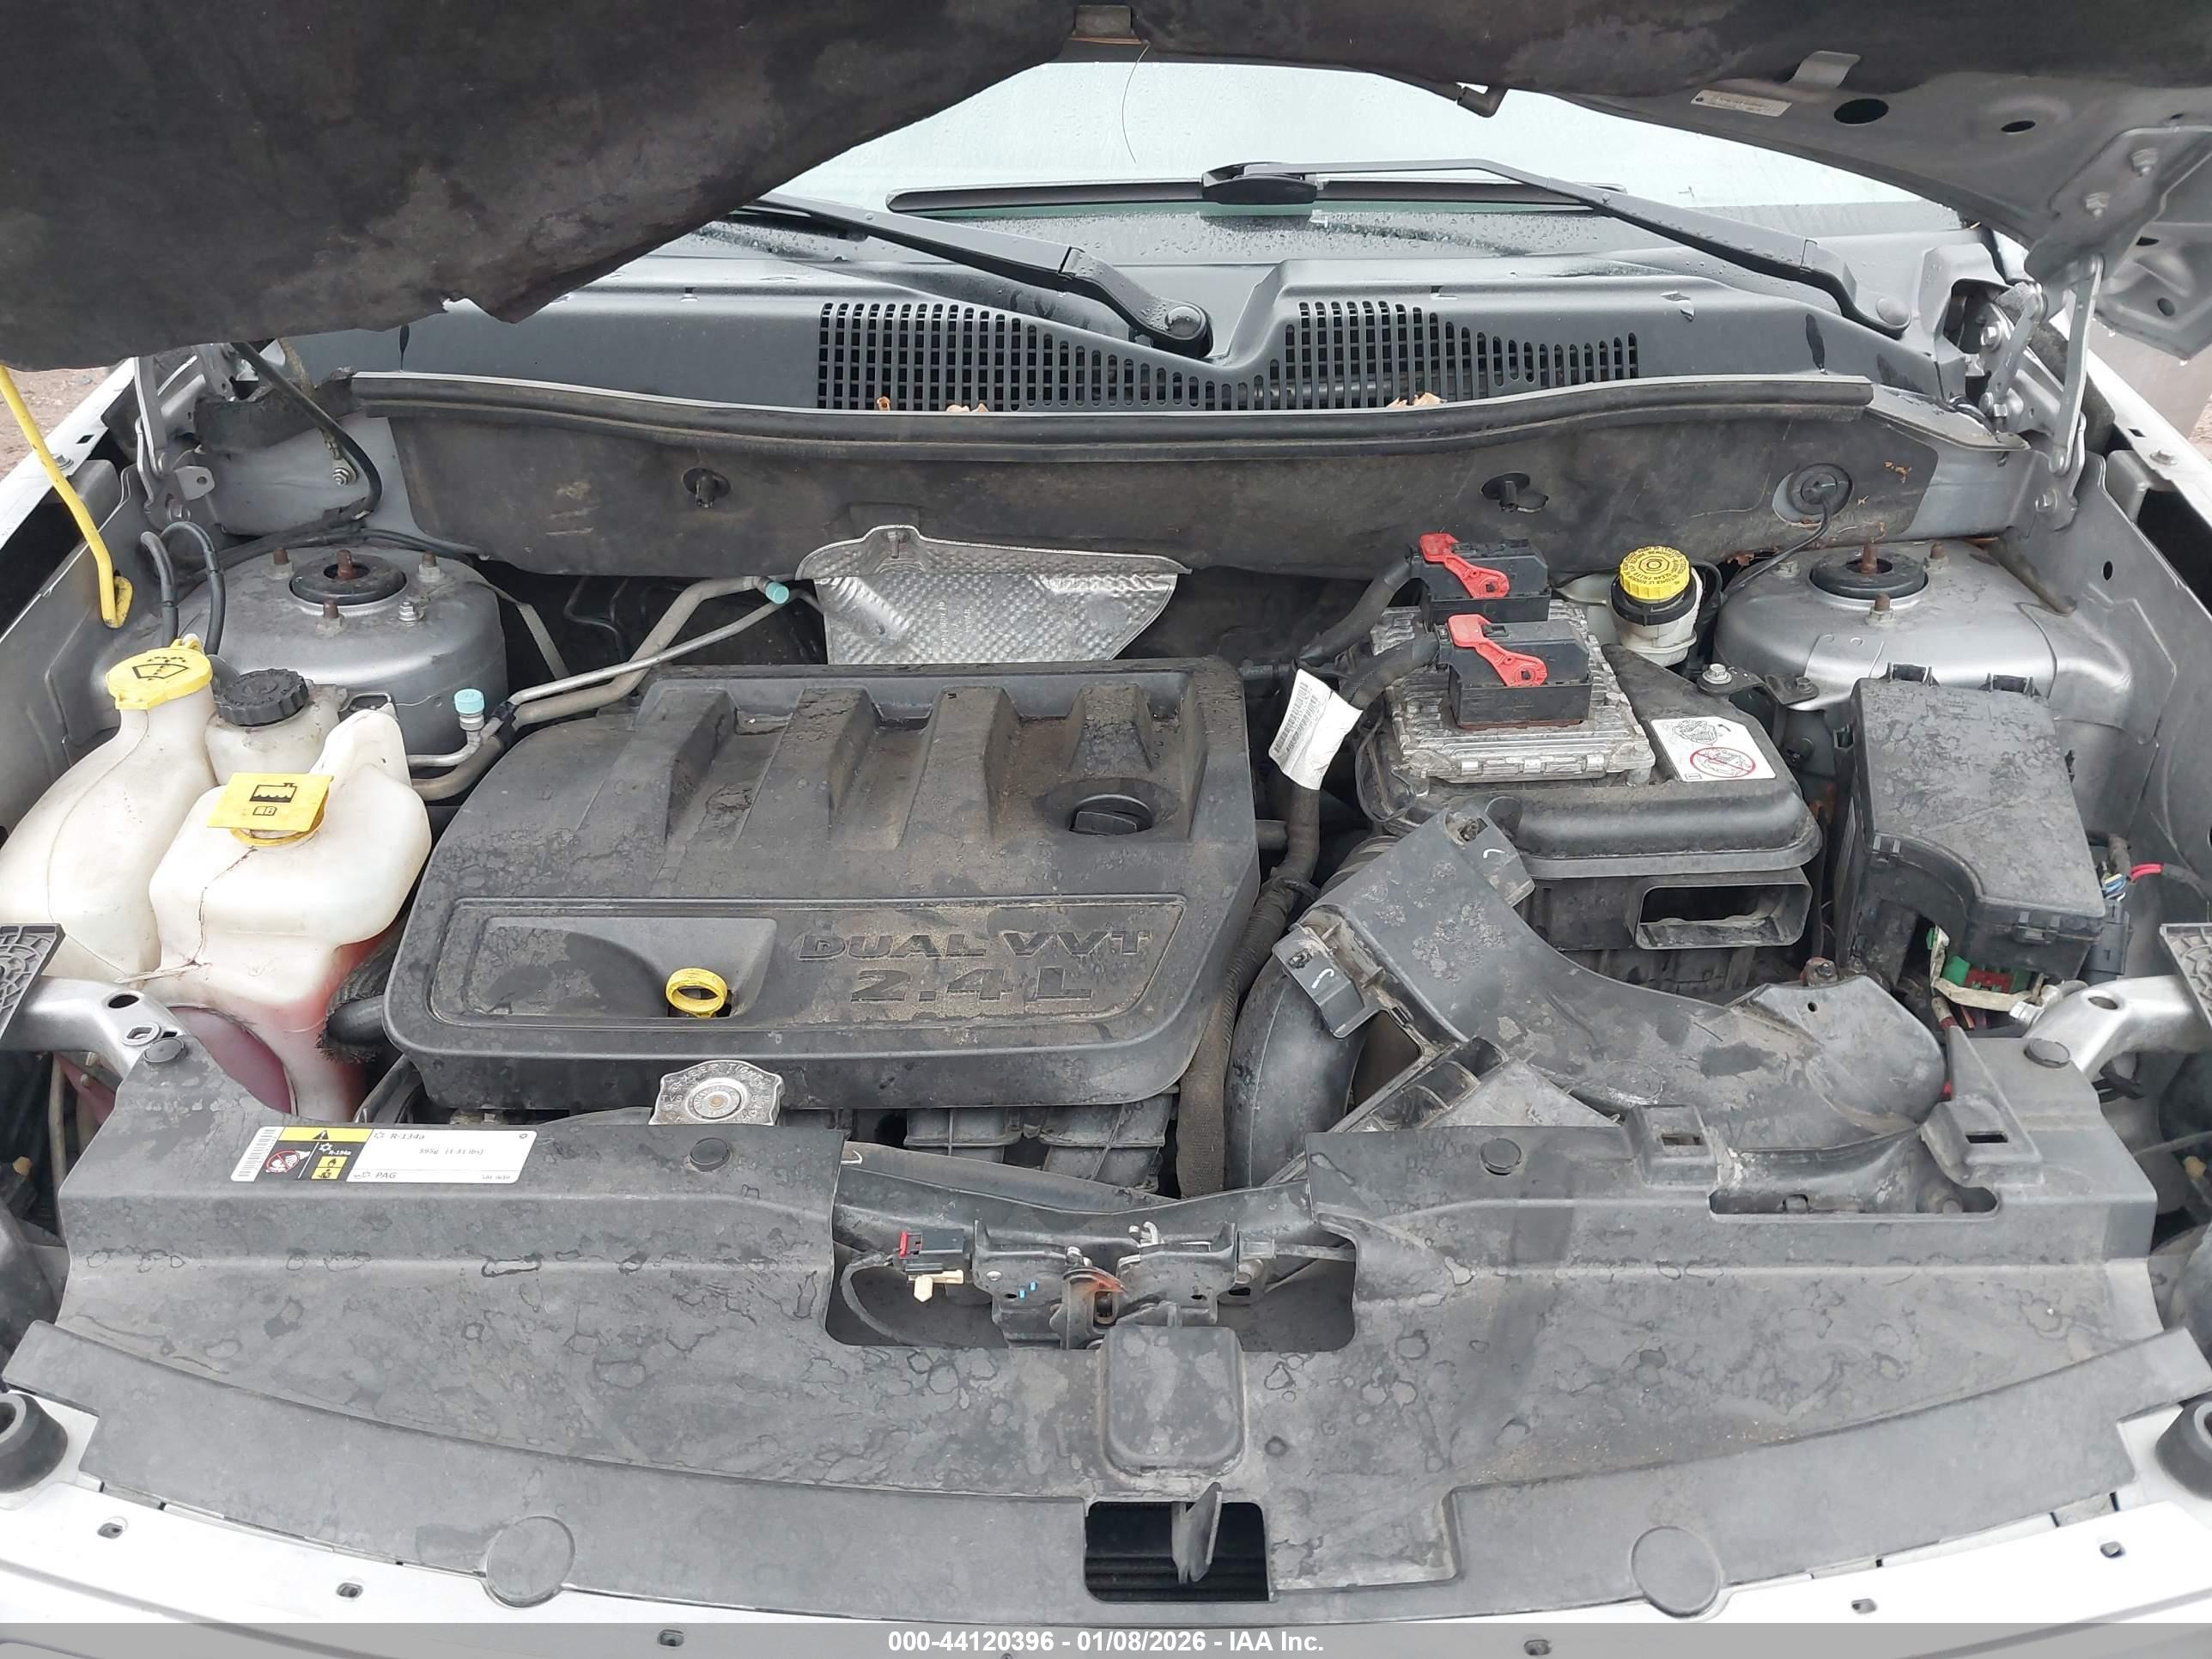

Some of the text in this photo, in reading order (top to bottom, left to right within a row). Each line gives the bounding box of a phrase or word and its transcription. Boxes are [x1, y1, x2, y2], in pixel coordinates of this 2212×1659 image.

[799, 929, 1152, 959] DUAL VVT
[851, 967, 1092, 1003] 2.4L
[682, 1064, 719, 1080] KEEP
